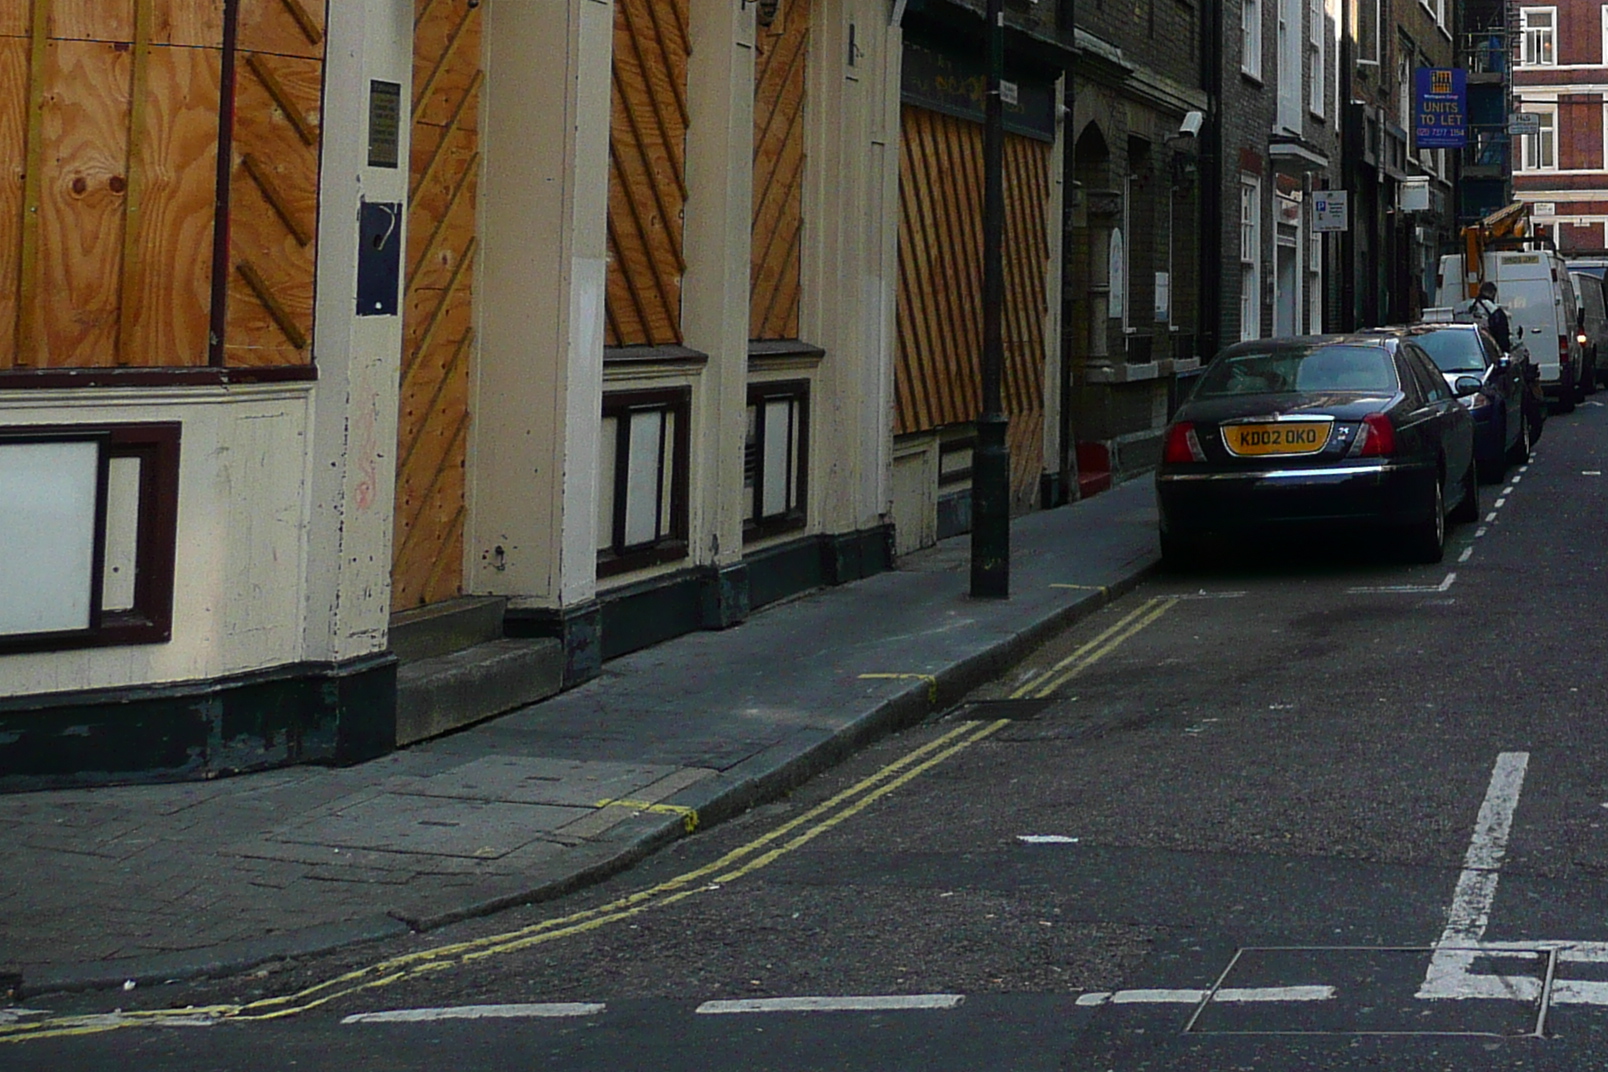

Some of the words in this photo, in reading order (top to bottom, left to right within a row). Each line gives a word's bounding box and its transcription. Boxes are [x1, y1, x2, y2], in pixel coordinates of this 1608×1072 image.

[1423, 102, 1458, 113] UNITS
[1420, 114, 1435, 125] TO
[1440, 114, 1463, 125] LET
[1240, 430, 1281, 446] KD02
